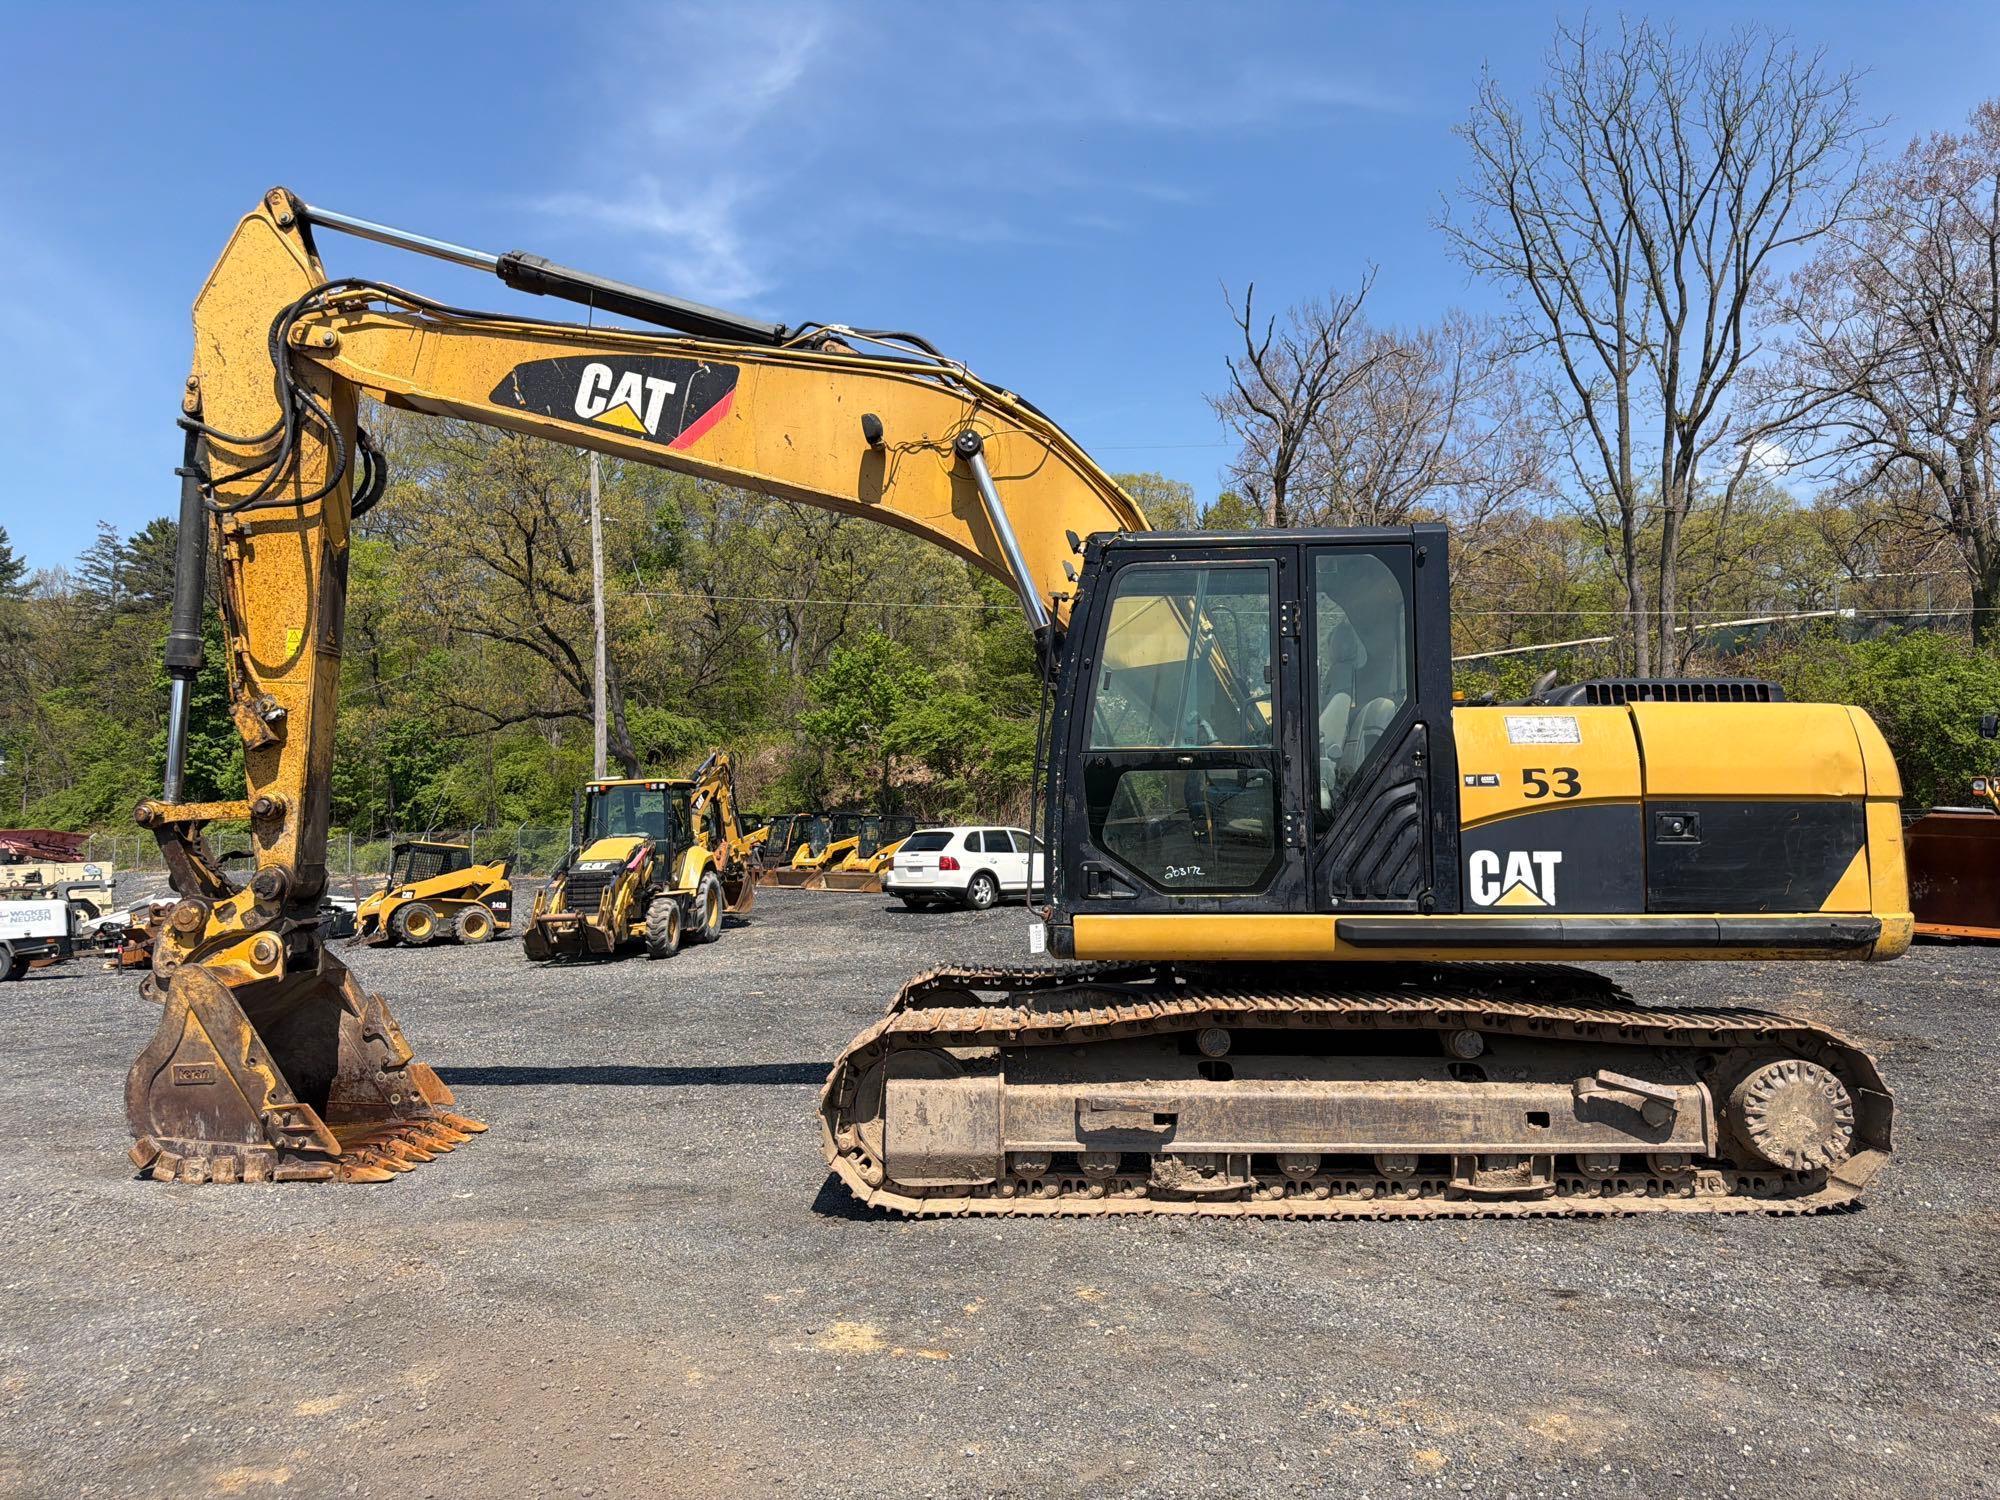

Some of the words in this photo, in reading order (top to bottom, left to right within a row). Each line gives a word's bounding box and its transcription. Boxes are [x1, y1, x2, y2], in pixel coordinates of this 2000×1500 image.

[574, 362, 677, 436] CAT
[1522, 767, 1582, 799] 53
[579, 862, 612, 871] CAT
[1164, 865, 1206, 880] 203172
[1469, 849, 1562, 906] CAT
[401, 891, 414, 899] CAT
[9, 908, 51, 917] WACKER
[10, 914, 52, 923] NEUSON
